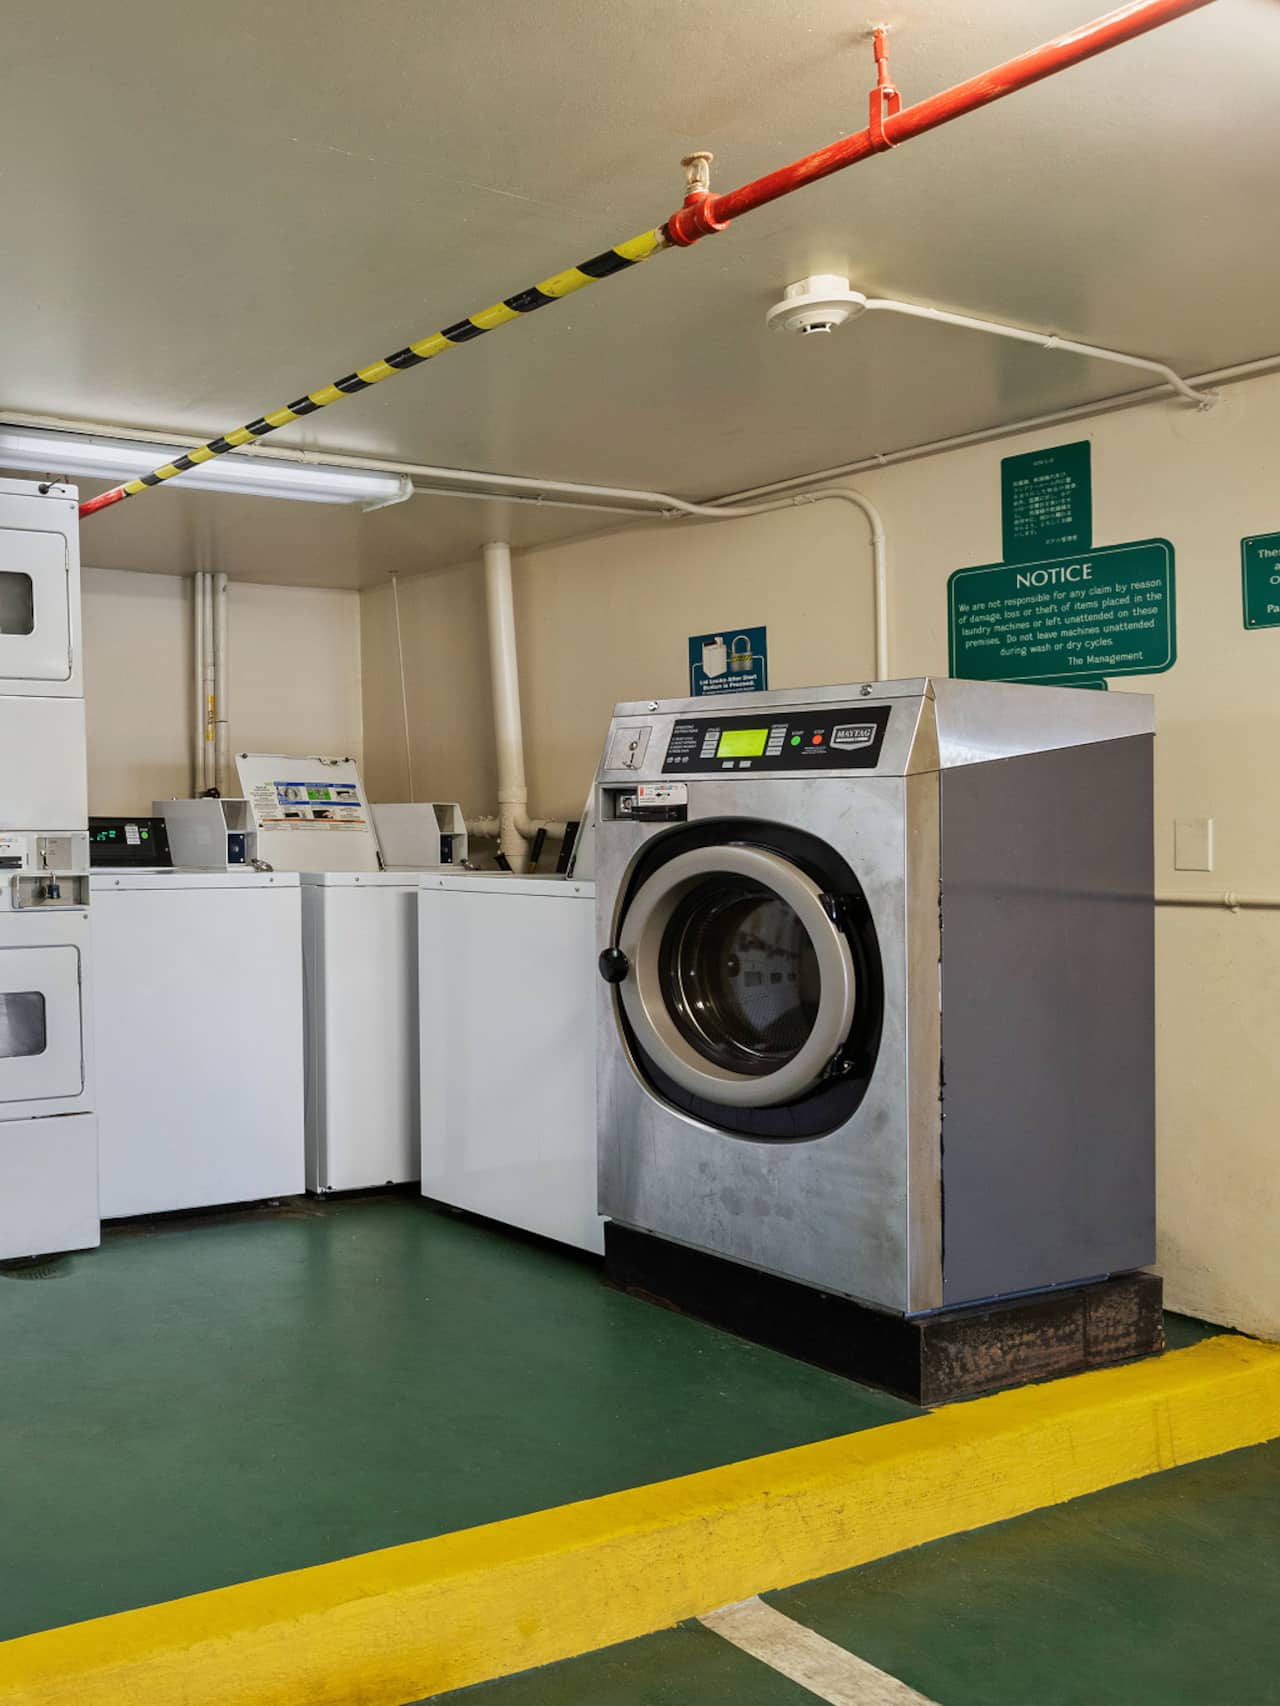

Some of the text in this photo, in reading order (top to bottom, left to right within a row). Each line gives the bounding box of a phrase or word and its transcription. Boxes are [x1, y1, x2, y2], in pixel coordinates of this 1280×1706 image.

[1258, 549, 1280, 558] The
[1016, 563, 1092, 589] NOTICE
[959, 579, 1162, 612] We are not responsible for any claim by reason
[959, 616, 967, 624] of
[1004, 610, 1021, 618] loss
[1036, 604, 1058, 615] theft
[1061, 602, 1071, 612] of
[1074, 600, 1099, 610] items
[1102, 595, 1130, 608] placed
[1134, 594, 1143, 603] in
[1147, 591, 1162, 601] the
[962, 624, 992, 636] laundry
[993, 621, 1030, 632] machines
[1045, 616, 1062, 626] left
[1064, 611, 1114, 624] unattended
[1117, 610, 1129, 618] on
[1133, 606, 1158, 616] these
[1006, 634, 1017, 643] Do
[1019, 633, 1033, 641] not
[1037, 631, 1058, 640] leave
[1060, 626, 1100, 637] machines
[1103, 619, 1155, 633] unattended
[1000, 646, 1028, 657] during
[1029, 643, 1052, 653] wash
[1066, 640, 1082, 650] dry
[1068, 651, 1143, 665] The Management
[837, 728, 871, 738] MAYTAG
